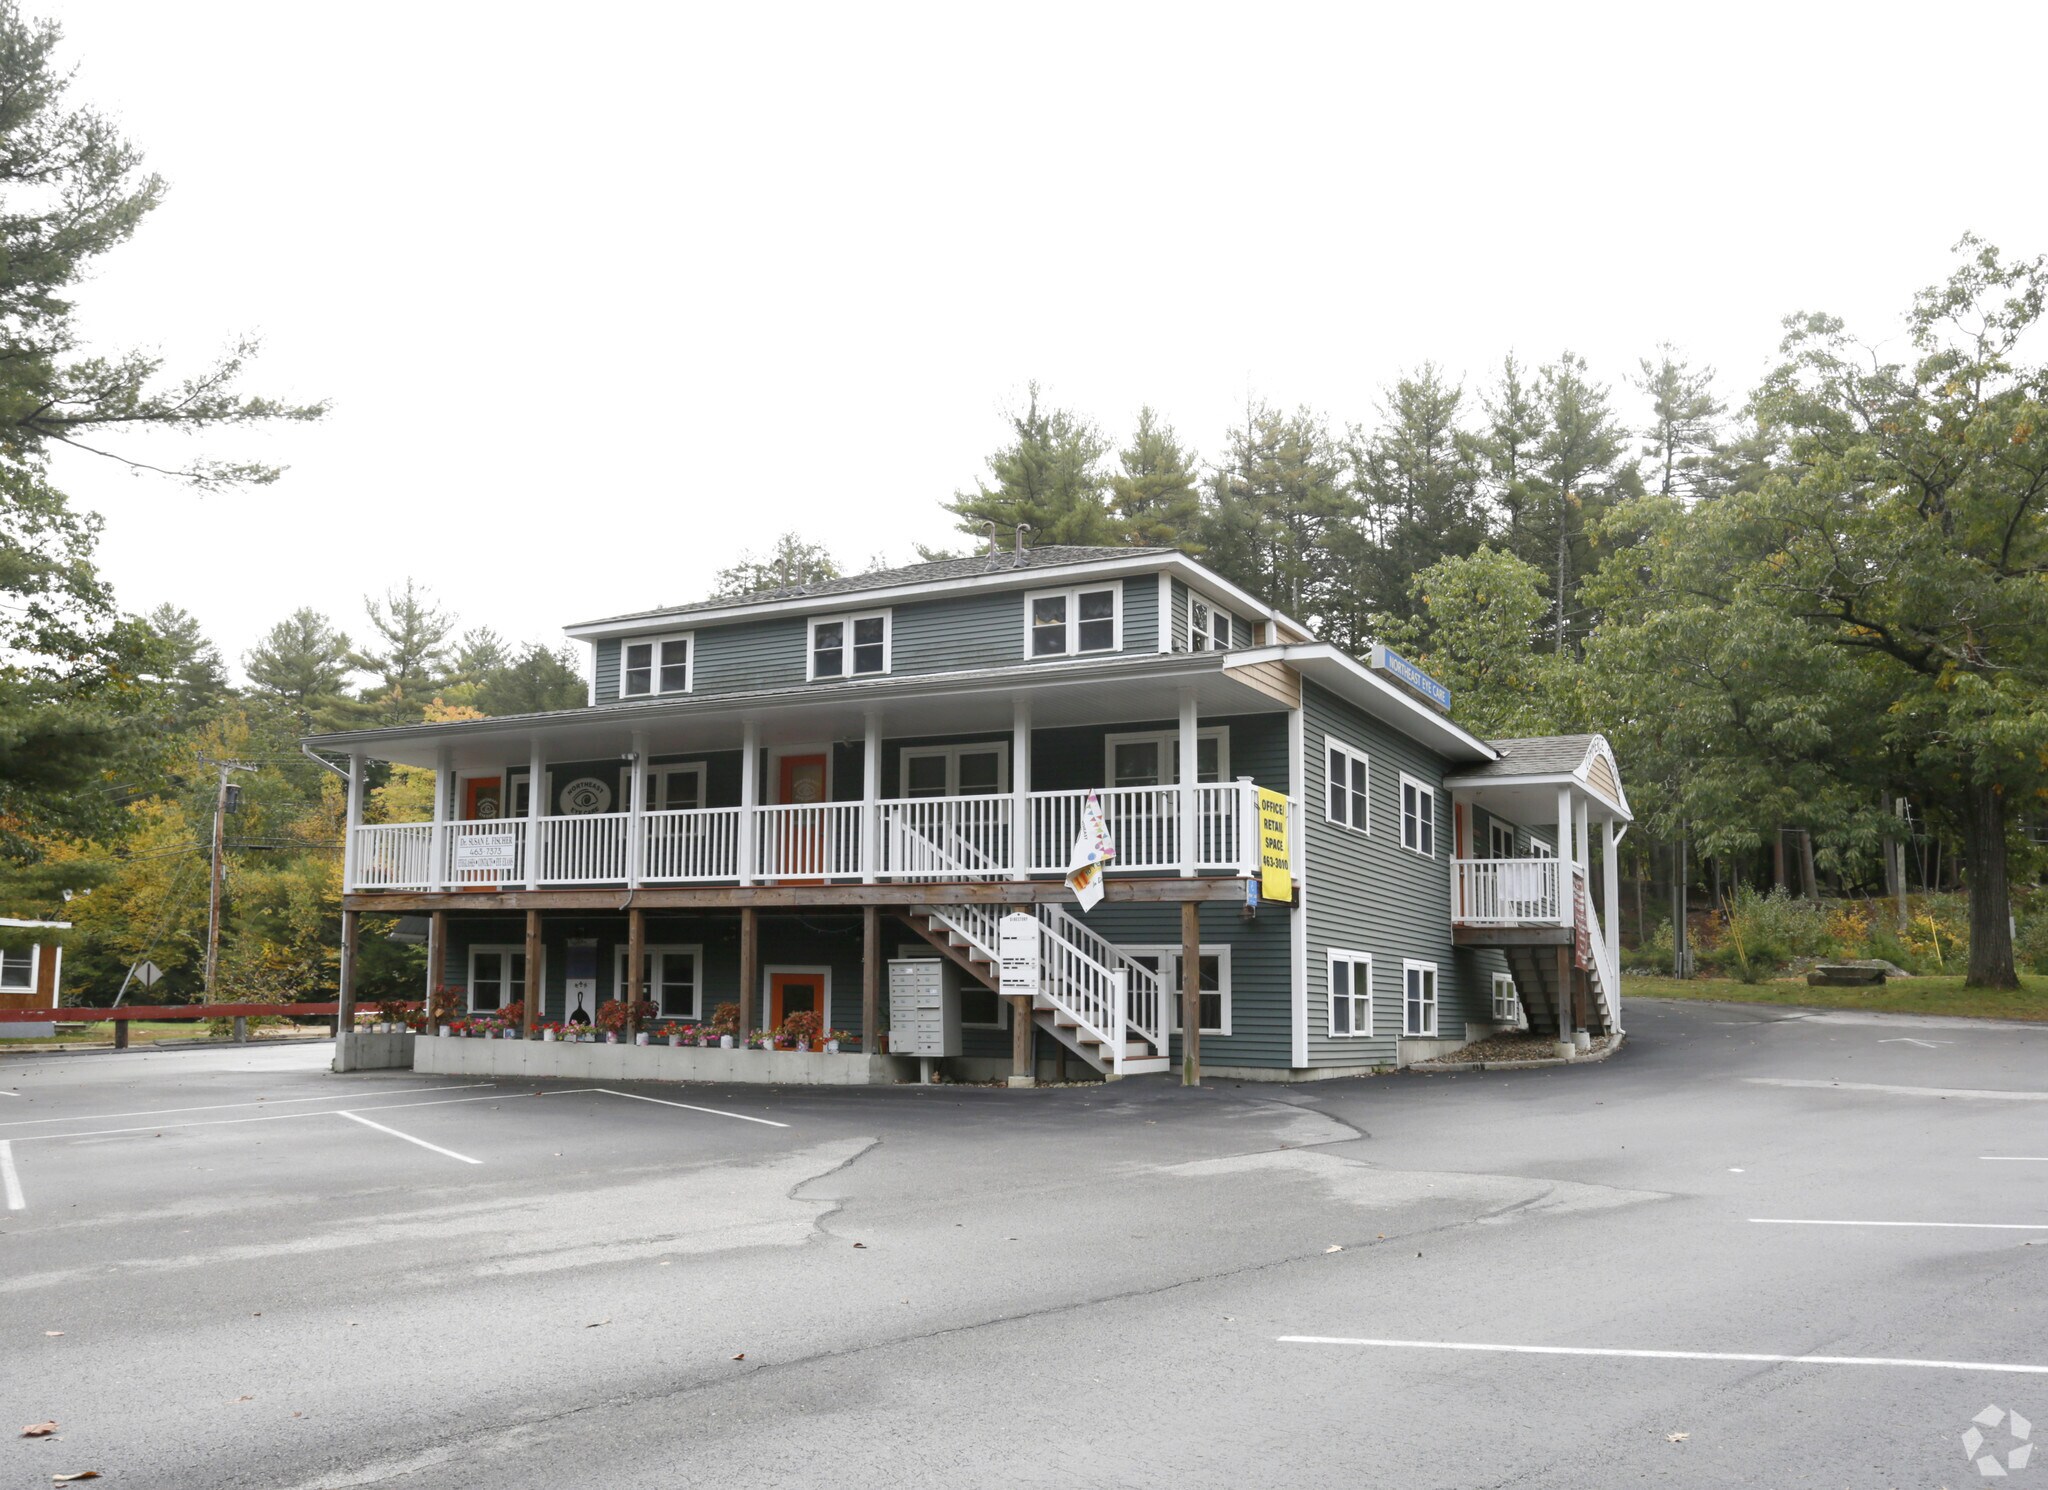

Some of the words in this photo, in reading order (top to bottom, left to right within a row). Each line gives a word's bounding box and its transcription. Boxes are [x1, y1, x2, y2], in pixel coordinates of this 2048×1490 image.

[1389, 655, 1421, 686] NORTHEAST
[1422, 677, 1432, 694] EYE
[1432, 685, 1446, 703] CARE
[567, 781, 604, 796] NORTHEAST
[1263, 818, 1284, 834] RETAIL
[468, 837, 485, 846] SUSAN
[491, 836, 513, 845] FISCHER
[1265, 837, 1284, 852] SPACE
[469, 847, 502, 855] 463-7373
